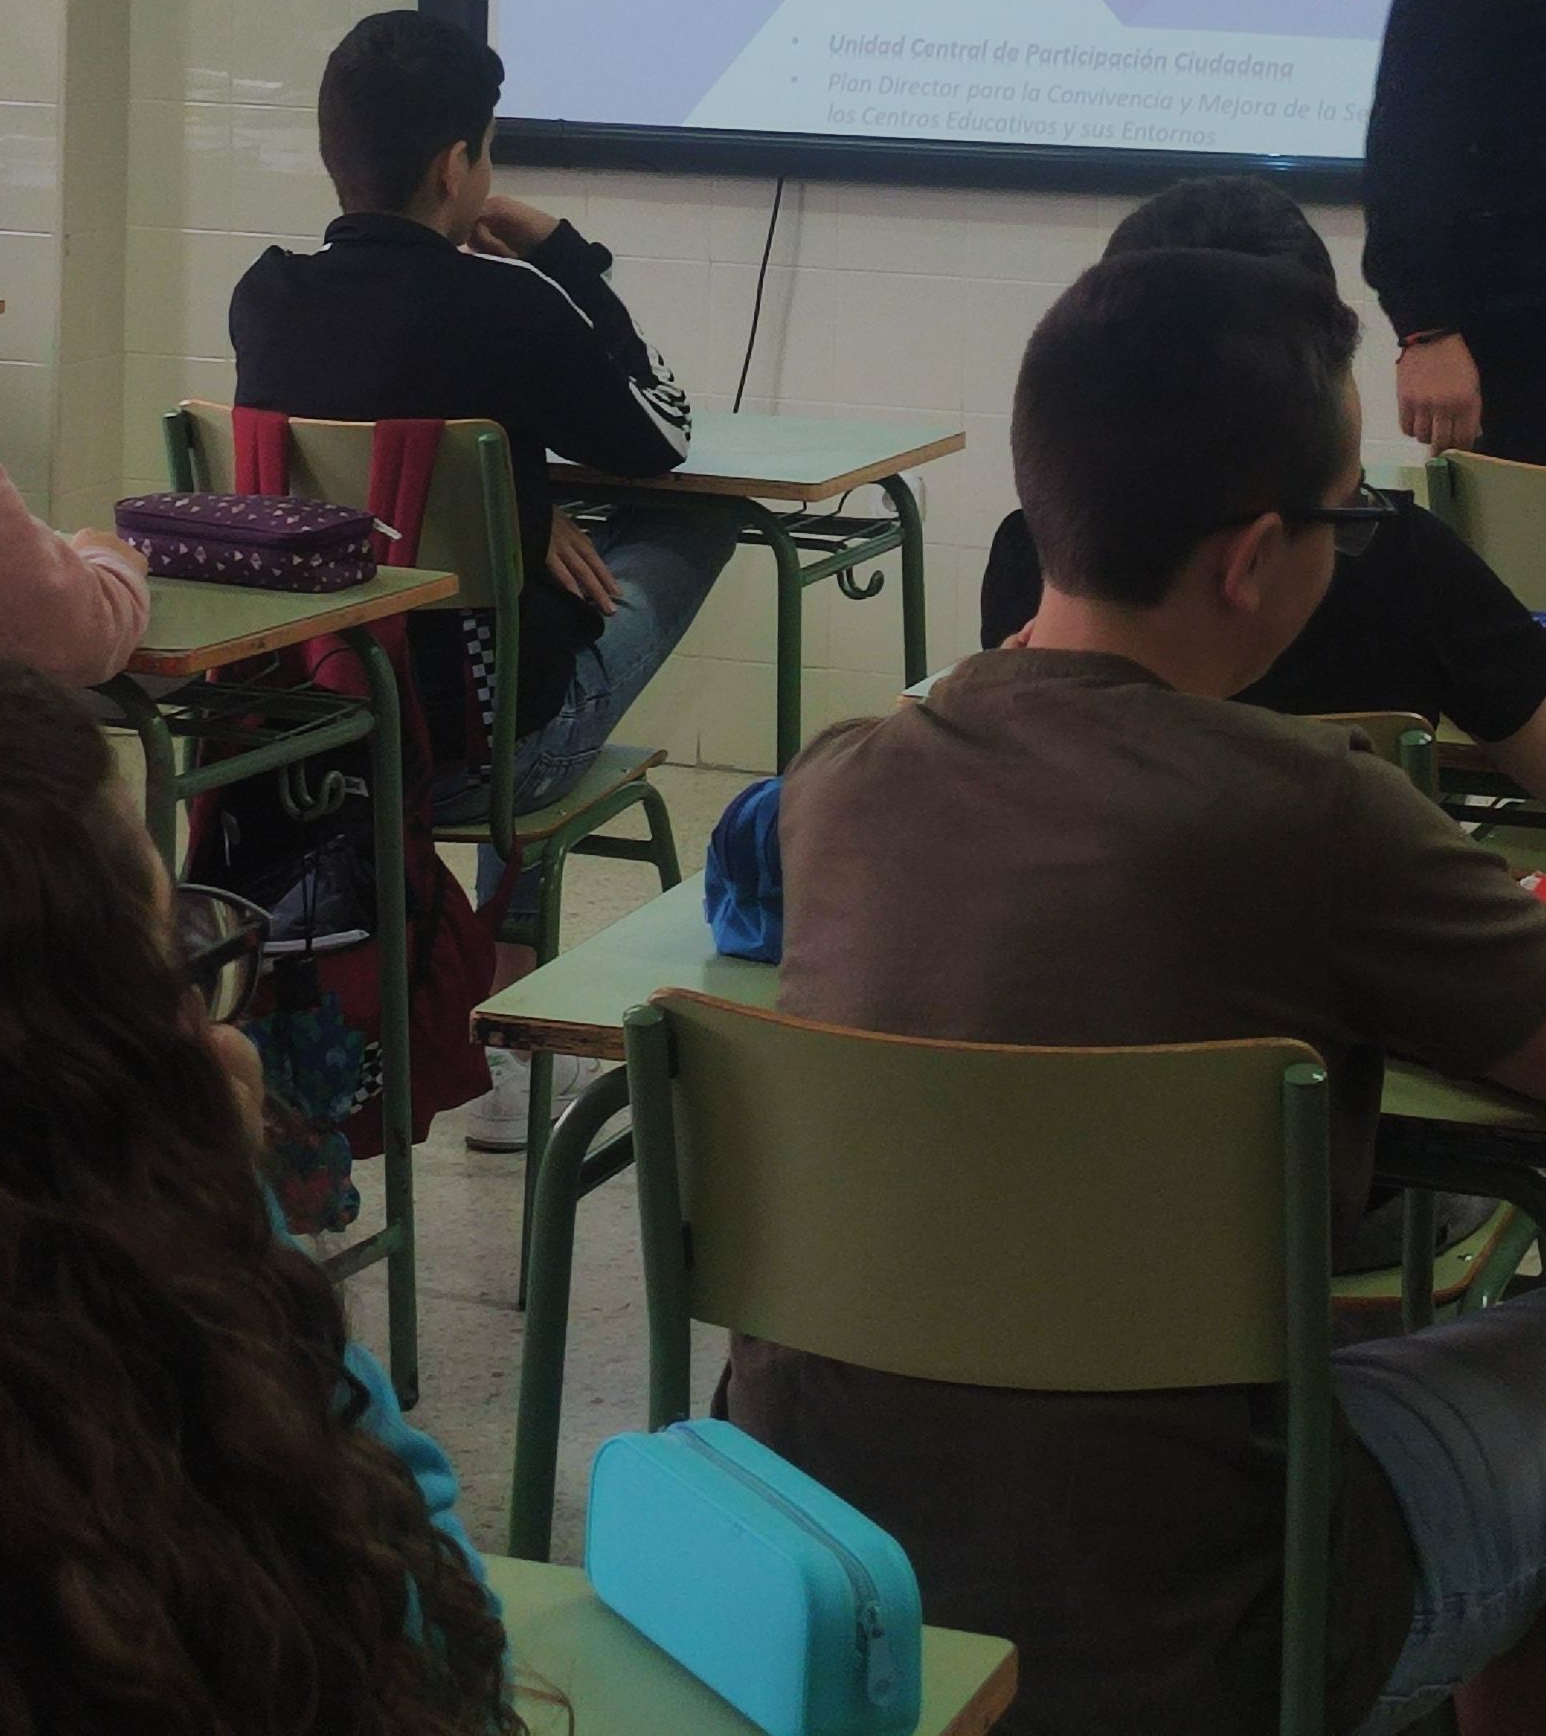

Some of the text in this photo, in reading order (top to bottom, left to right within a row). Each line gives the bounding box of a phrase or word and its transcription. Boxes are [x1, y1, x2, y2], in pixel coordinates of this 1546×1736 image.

[829, 34, 1294, 80] Unidad Central de Participación Ciudadana
[828, 72, 872, 94] Plan
[878, 75, 961, 98] Director
[966, 83, 1015, 107] para
[1021, 81, 1041, 103] la
[1046, 84, 1174, 111] Convivencia
[1180, 95, 1193, 114] y
[1198, 93, 1278, 121] Mejora
[1283, 97, 1310, 120] de
[1317, 99, 1337, 121] la
[826, 102, 1217, 147] los Centros Educativos y sus Entornos
